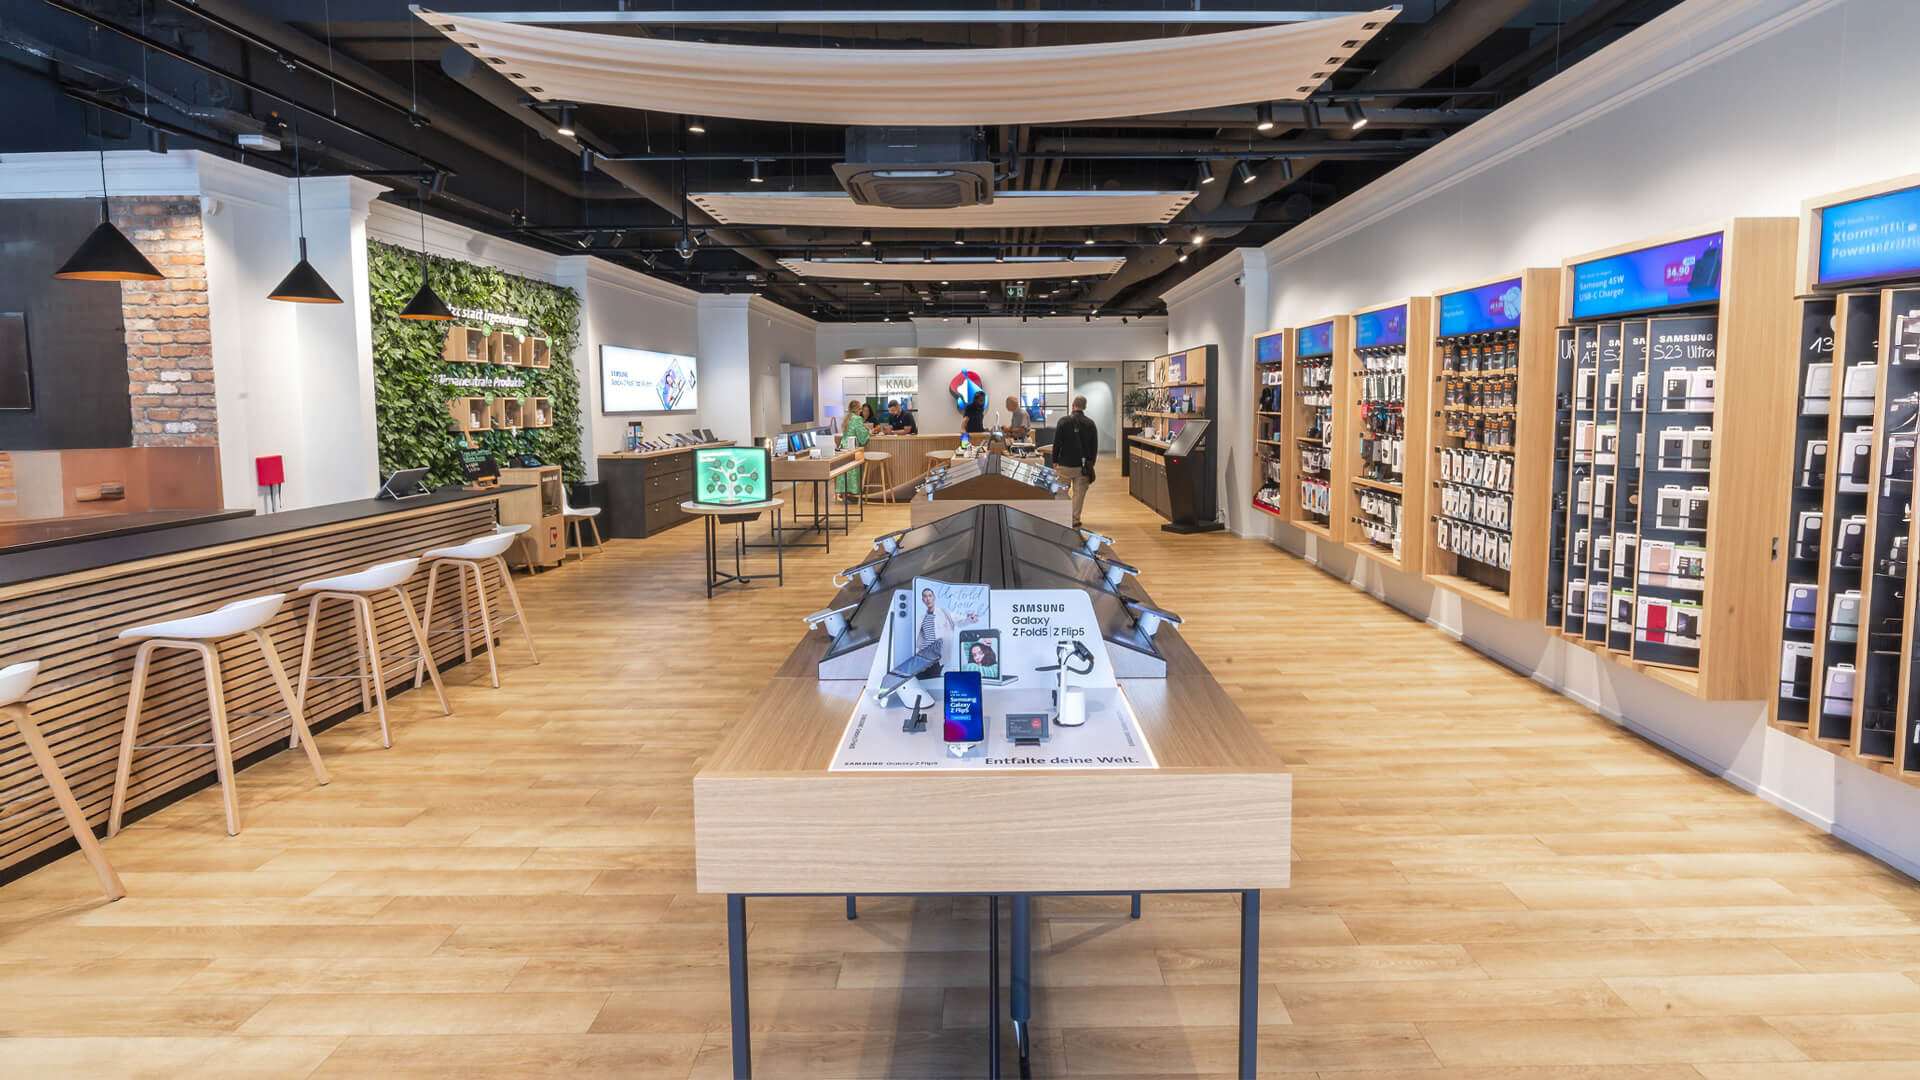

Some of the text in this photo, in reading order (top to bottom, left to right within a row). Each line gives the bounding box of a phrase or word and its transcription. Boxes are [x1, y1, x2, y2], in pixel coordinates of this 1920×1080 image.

[1599, 287, 1625, 299] Charger
[1659, 333, 1713, 344] SAMSUNG
[1653, 345, 1715, 360] S23 Ultra
[886, 379, 912, 389] KMU
[1012, 603, 1065, 613] SAMSUNG
[1011, 616, 1050, 627] Galaxy
[1012, 627, 1085, 639] Z Fold5 Z Flip5
[985, 756, 1140, 765] Entfalte deine Welt.
